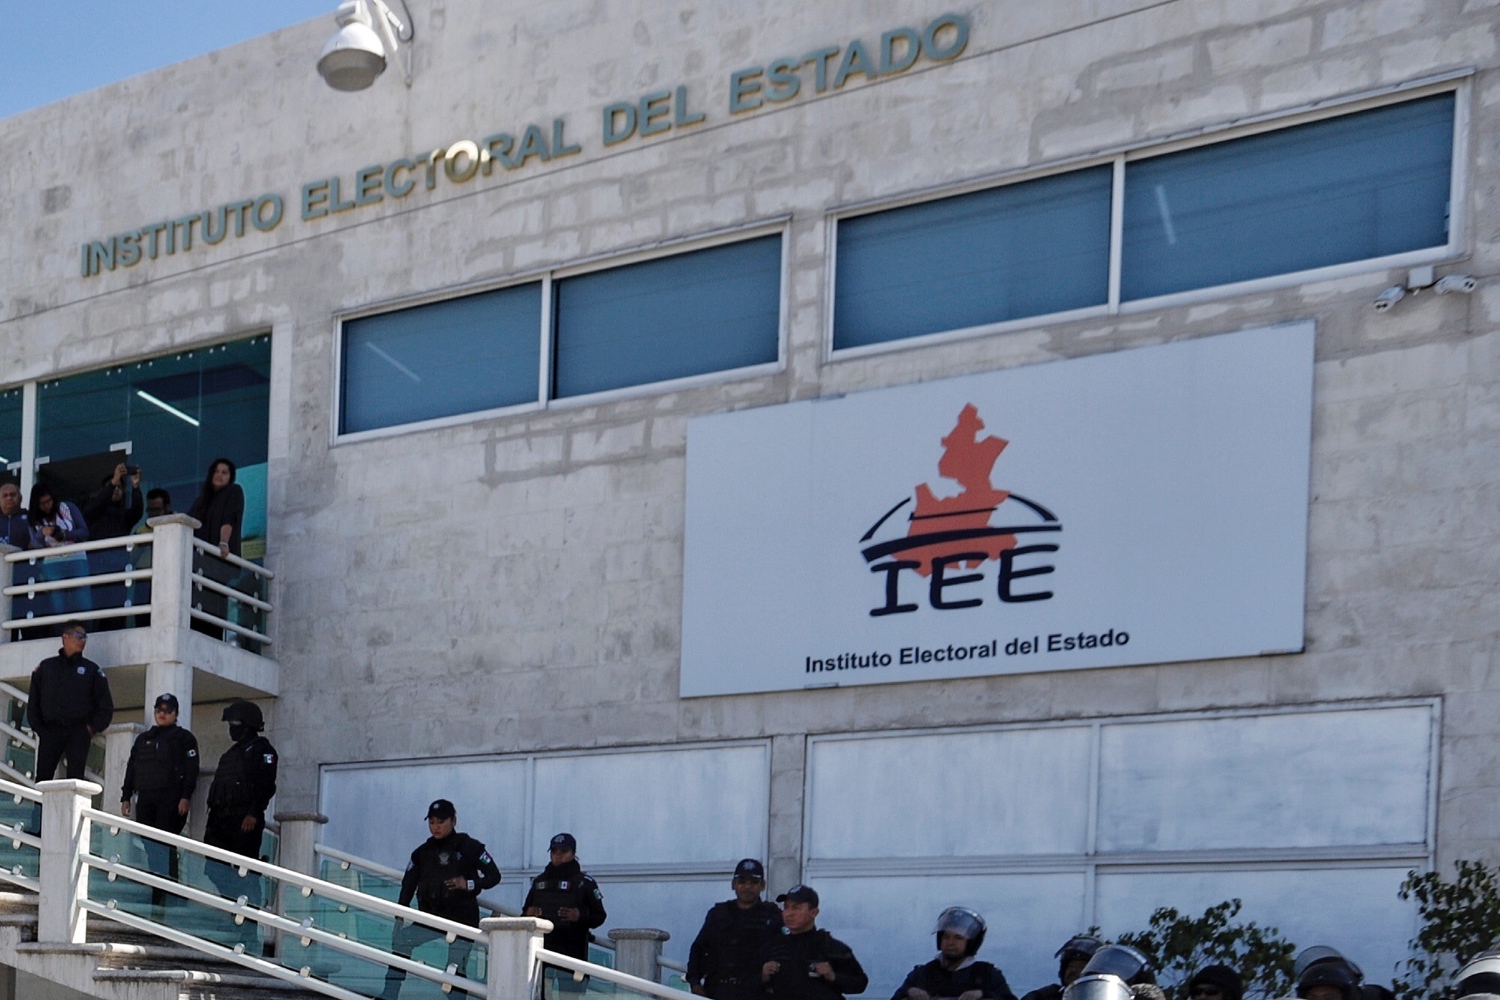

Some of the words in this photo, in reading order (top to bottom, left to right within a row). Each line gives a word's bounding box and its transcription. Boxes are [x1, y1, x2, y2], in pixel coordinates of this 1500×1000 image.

[80, 193, 284, 277] INSTITUTO
[301, 118, 581, 221] ELECTORAL
[602, 86, 705, 146] DEL
[729, 13, 970, 115] ESTADO
[869, 543, 1061, 617] IEE
[805, 652, 892, 673] Instituto
[899, 640, 997, 666] Electoral
[1004, 637, 1040, 656] del
[1047, 629, 1130, 652] Estado
